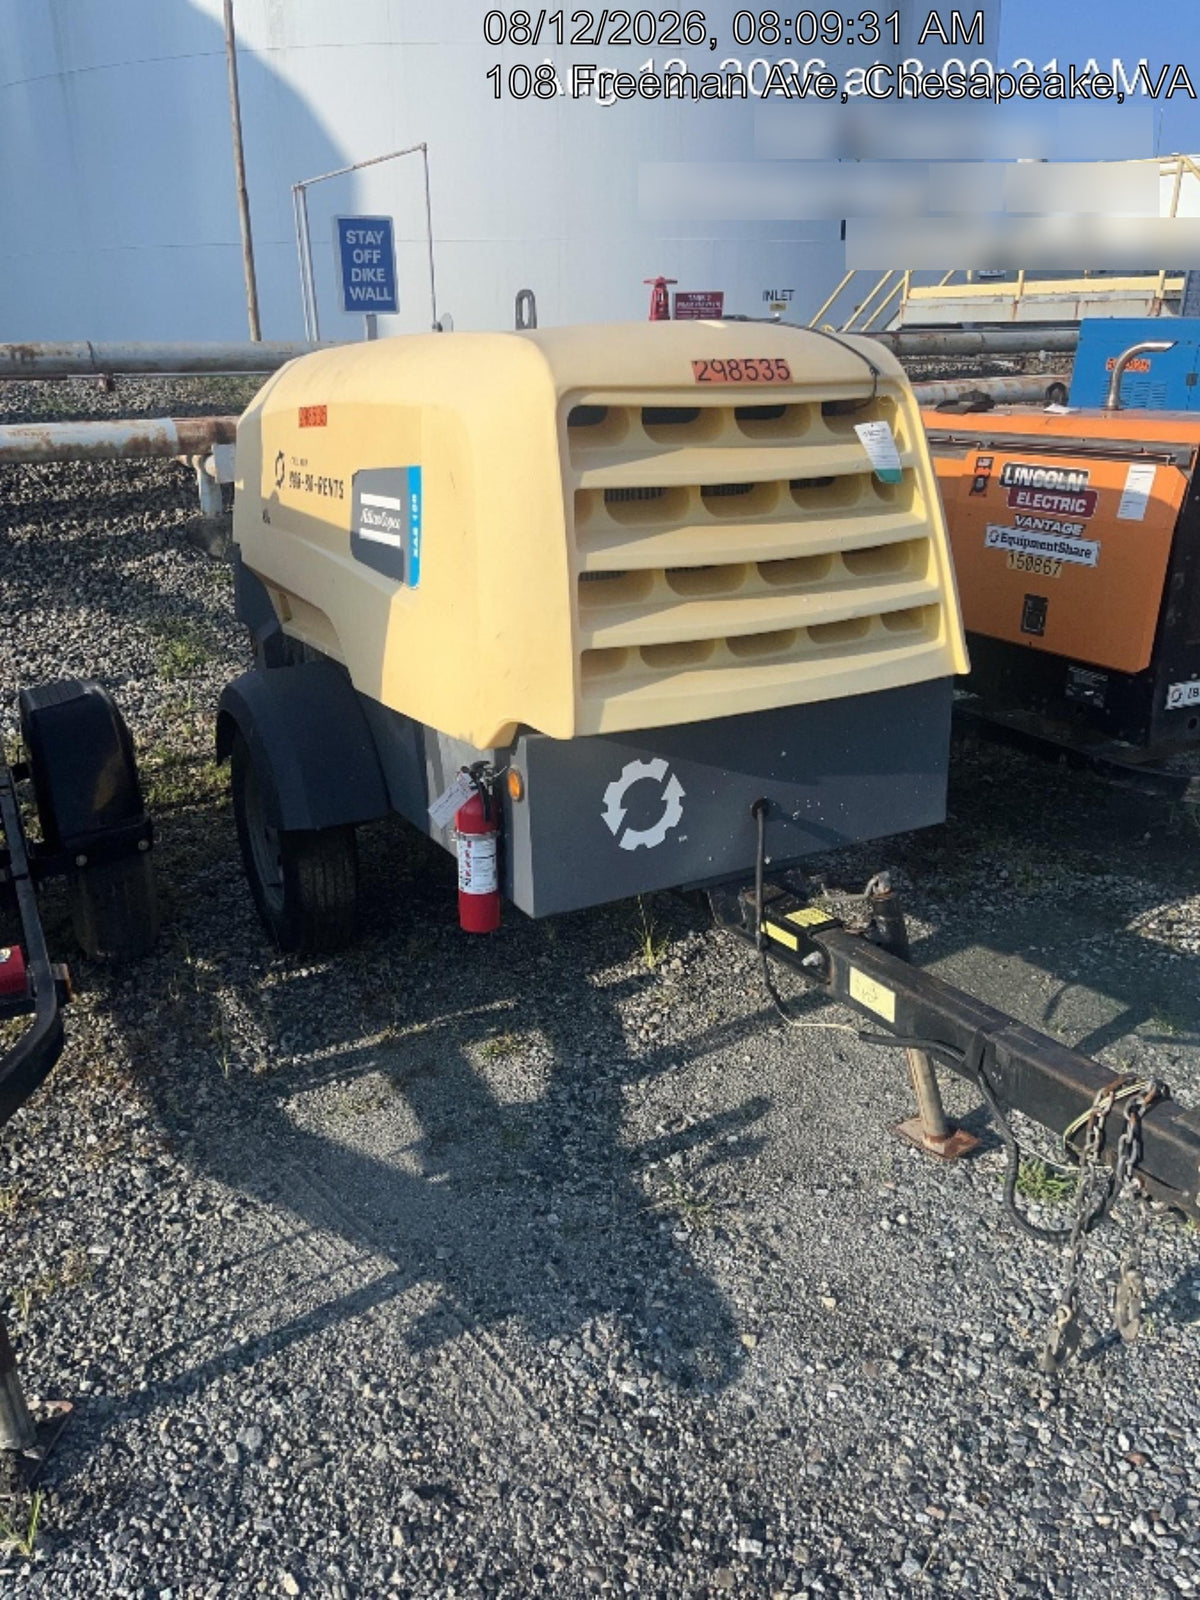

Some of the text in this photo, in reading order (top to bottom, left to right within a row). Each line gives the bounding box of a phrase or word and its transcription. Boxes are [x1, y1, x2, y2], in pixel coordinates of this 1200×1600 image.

[345, 230, 385, 245] STAY
[353, 249, 382, 264] OFF
[351, 268, 387, 282] DIKE
[349, 286, 393, 301] WALL
[762, 289, 796, 302] INLET
[696, 358, 791, 382] 298535
[1003, 466, 1086, 493] LINCOLN
[1016, 491, 1088, 514] ELECTRIC
[1014, 515, 1084, 537] VANTAGE
[1000, 532, 1093, 559] EquipmentShare
[1008, 553, 1062, 576] 150867
